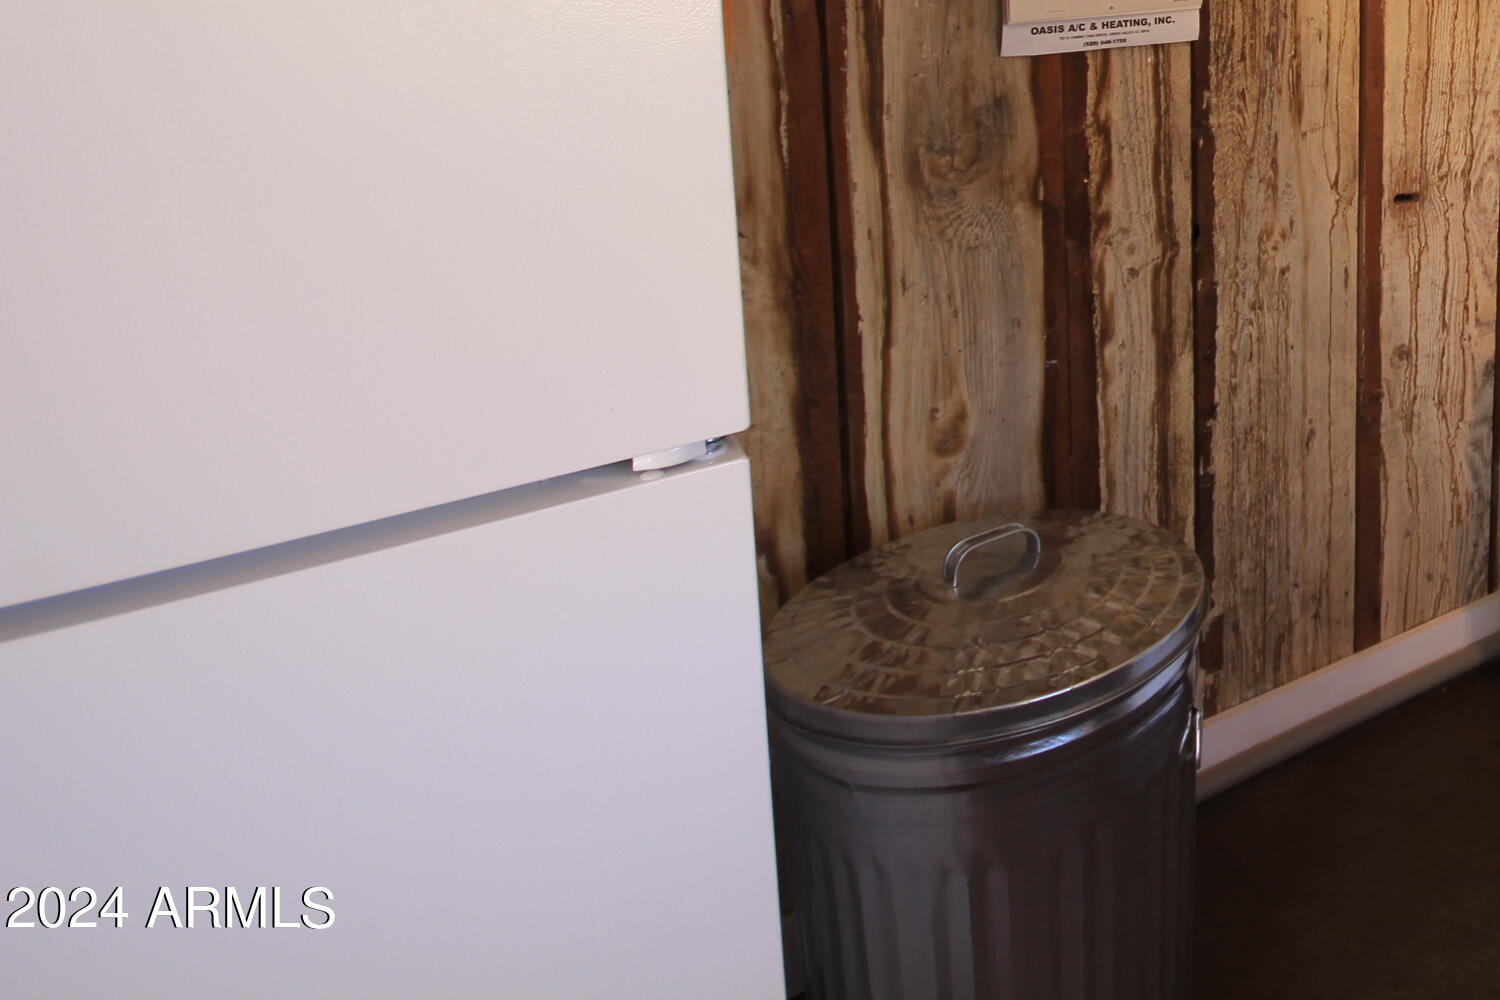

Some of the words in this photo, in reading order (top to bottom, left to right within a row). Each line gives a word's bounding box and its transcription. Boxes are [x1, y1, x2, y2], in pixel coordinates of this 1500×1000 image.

[1031, 25, 1065, 37] OASIS
[1068, 22, 1086, 33] A/C
[1090, 22, 1098, 31] &
[1101, 17, 1151, 30] HEATING,
[1154, 15, 1176, 25] INC.
